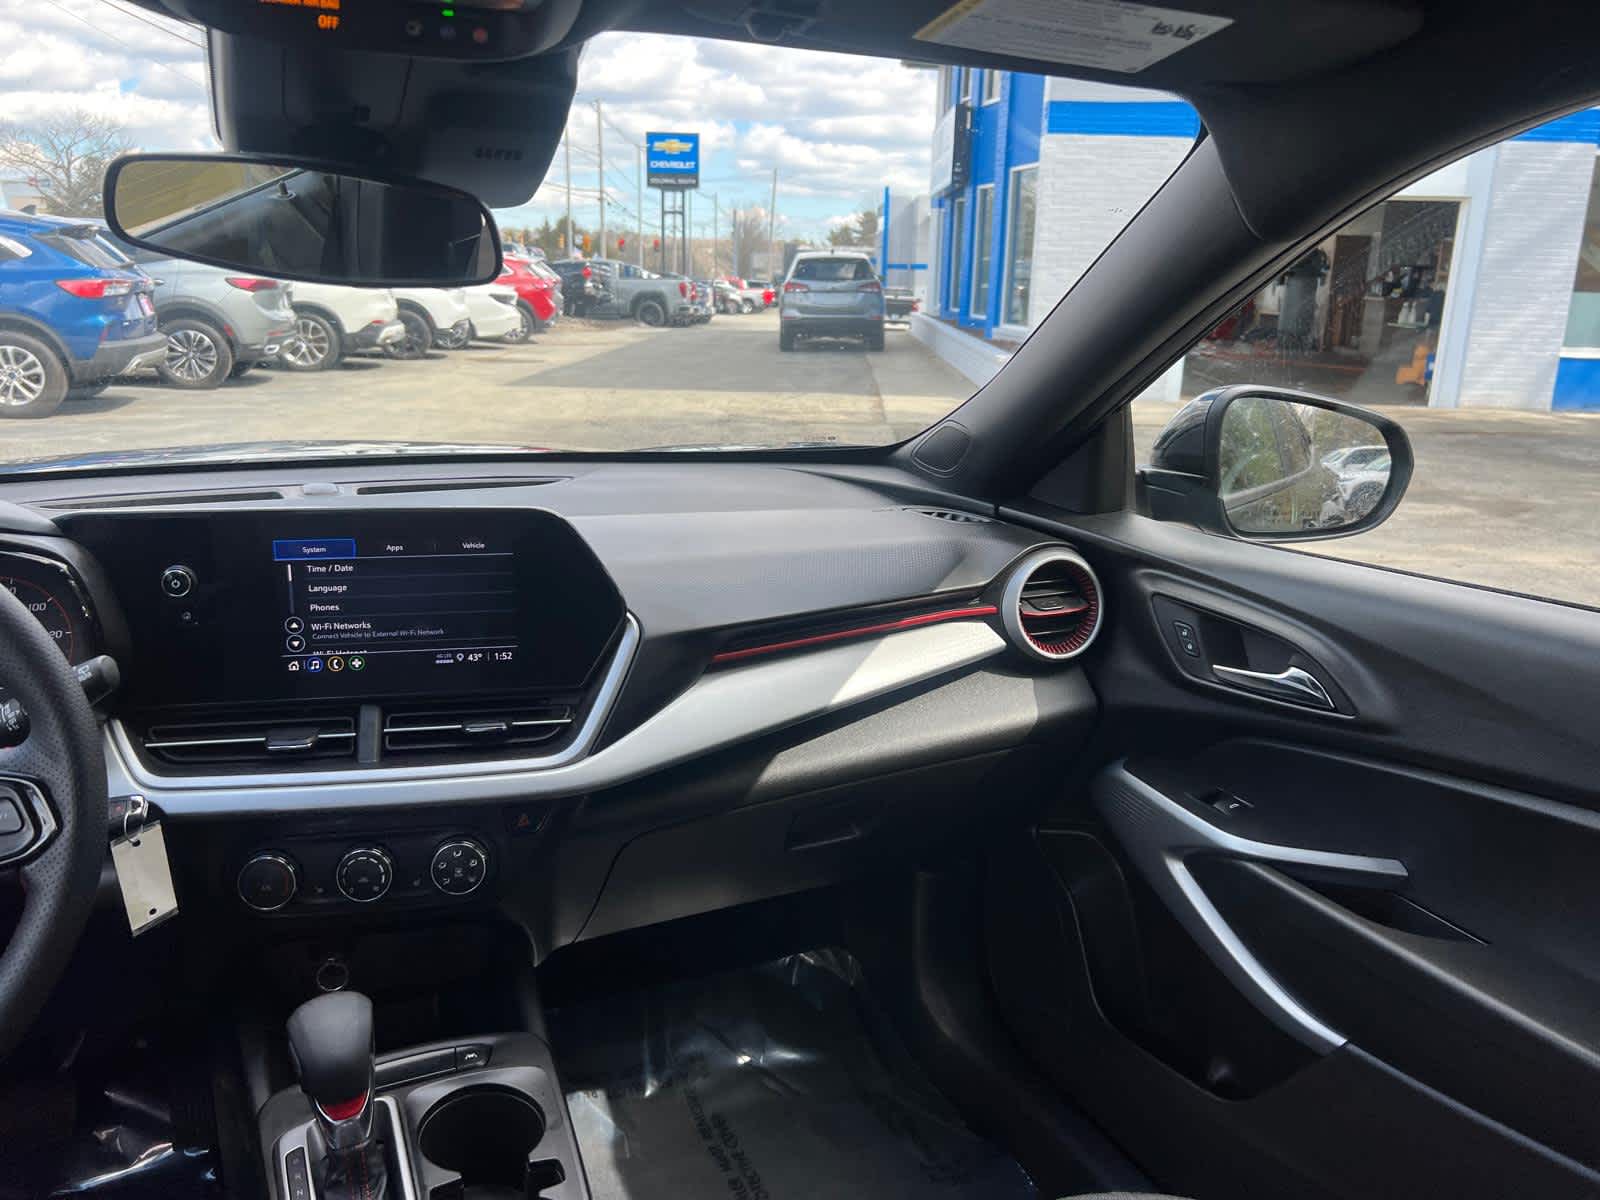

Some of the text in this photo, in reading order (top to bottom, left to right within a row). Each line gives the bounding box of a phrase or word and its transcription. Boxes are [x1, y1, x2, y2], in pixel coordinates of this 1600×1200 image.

[317, 14, 340, 31] OFF
[650, 161, 696, 169] CHEVROLET
[302, 545, 326, 554] System
[386, 543, 404, 553] Apps
[462, 541, 485, 549] Vehicle
[307, 563, 354, 573] Time / Date
[308, 583, 348, 594] Language
[28, 602, 47, 612] 100
[310, 603, 340, 612] Phones
[311, 621, 372, 631] Wi-Fi Networks
[312, 632, 339, 640] Connect
[340, 631, 363, 639] Vehicle
[372, 630, 398, 638] External
[417, 628, 444, 636] Network
[494, 651, 513, 660] 1:52
